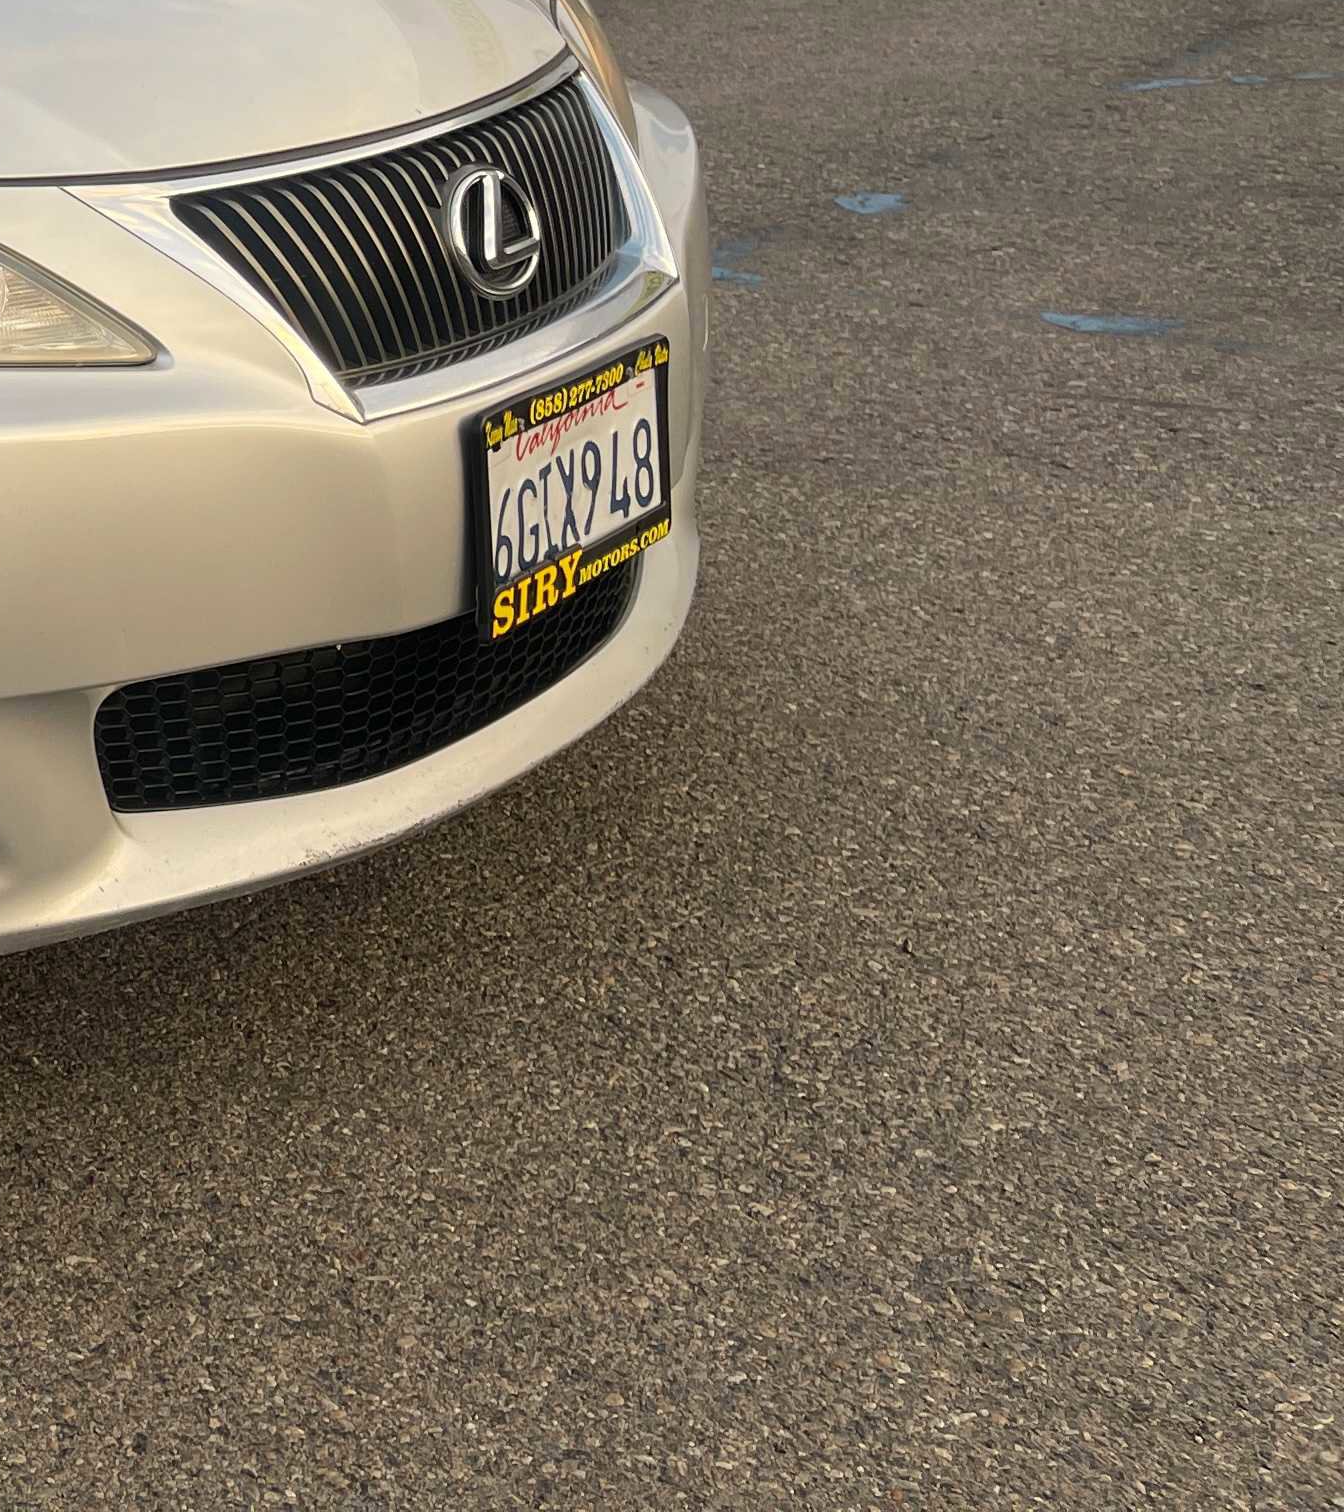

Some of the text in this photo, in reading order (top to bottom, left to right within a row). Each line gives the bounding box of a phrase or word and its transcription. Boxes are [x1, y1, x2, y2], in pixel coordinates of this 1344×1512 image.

[515, 387, 629, 462] California
[529, 390, 568, 425] (858)
[492, 519, 670, 639] SIRY MOTORS.COM
